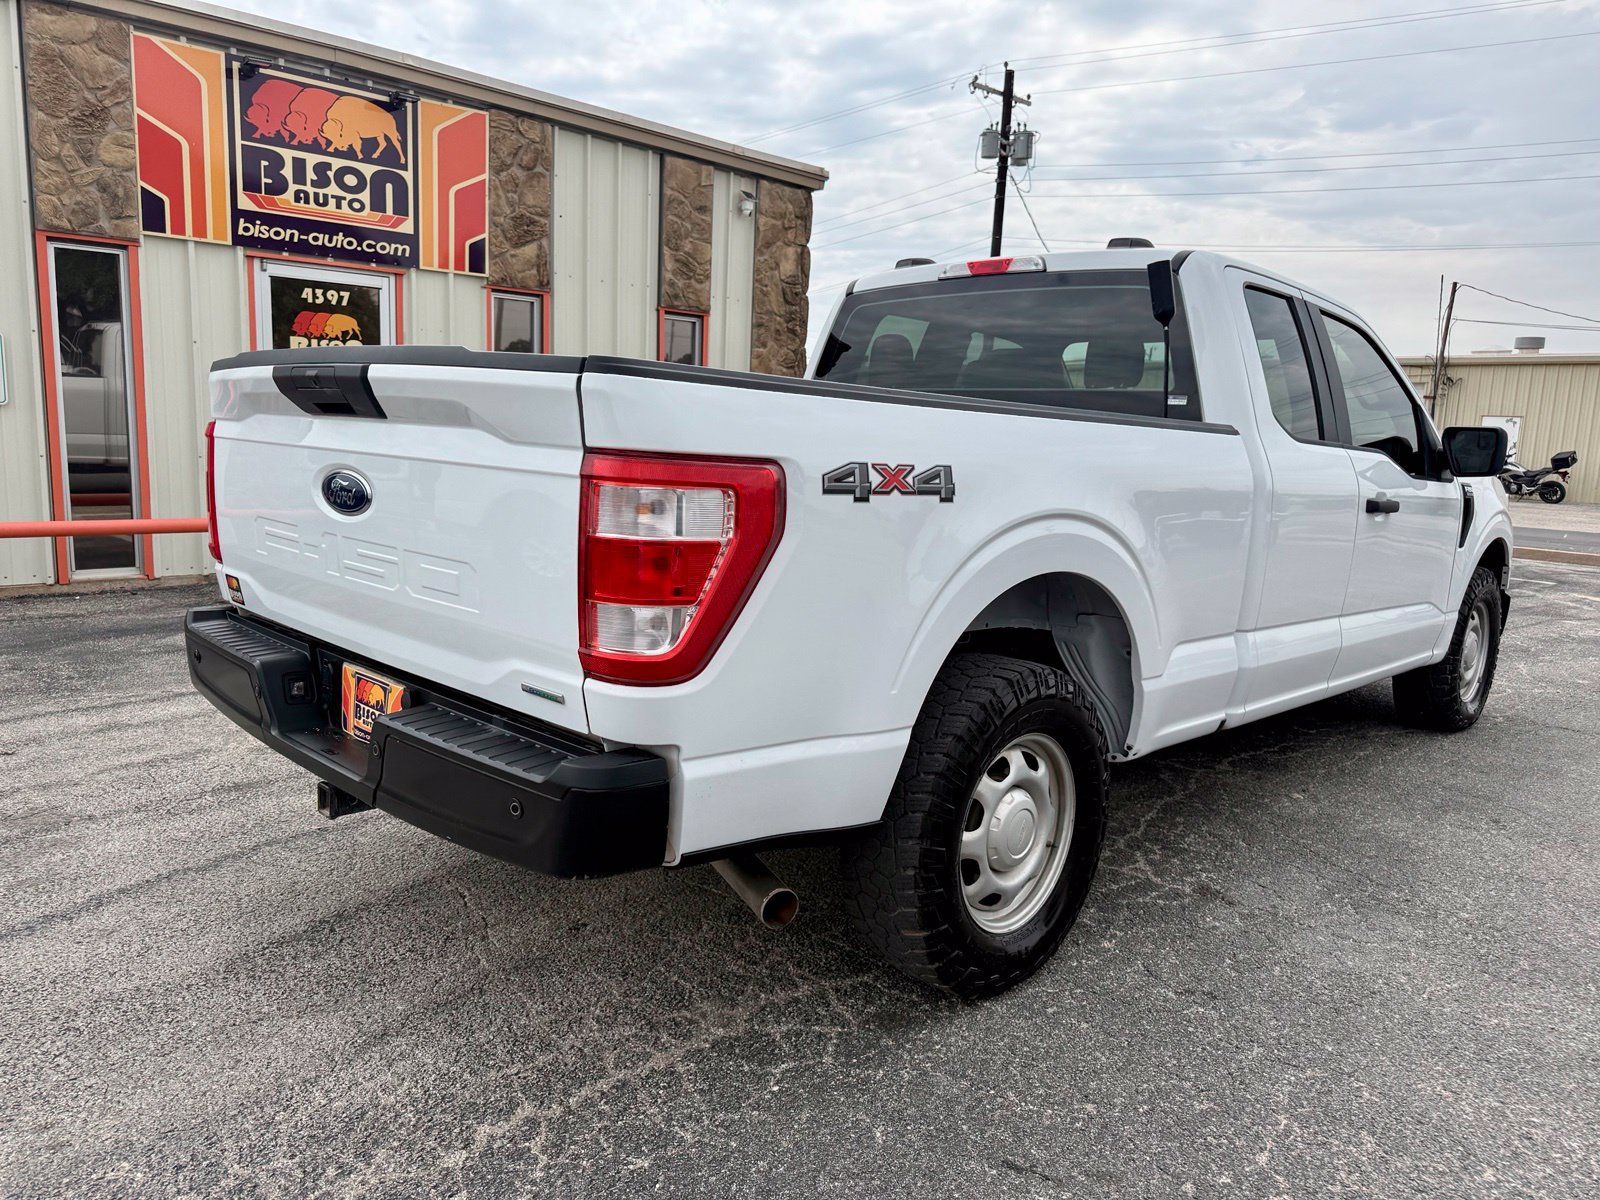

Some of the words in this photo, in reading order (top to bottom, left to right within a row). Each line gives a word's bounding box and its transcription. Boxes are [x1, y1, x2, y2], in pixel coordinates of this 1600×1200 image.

[241, 144, 409, 218] BISON
[293, 188, 366, 213] AUTO
[237, 218, 411, 257] bison-auto.com
[301, 287, 351, 307] 4397
[328, 478, 356, 506] Ford
[254, 515, 480, 613] F-150
[355, 702, 382, 721] BISO
